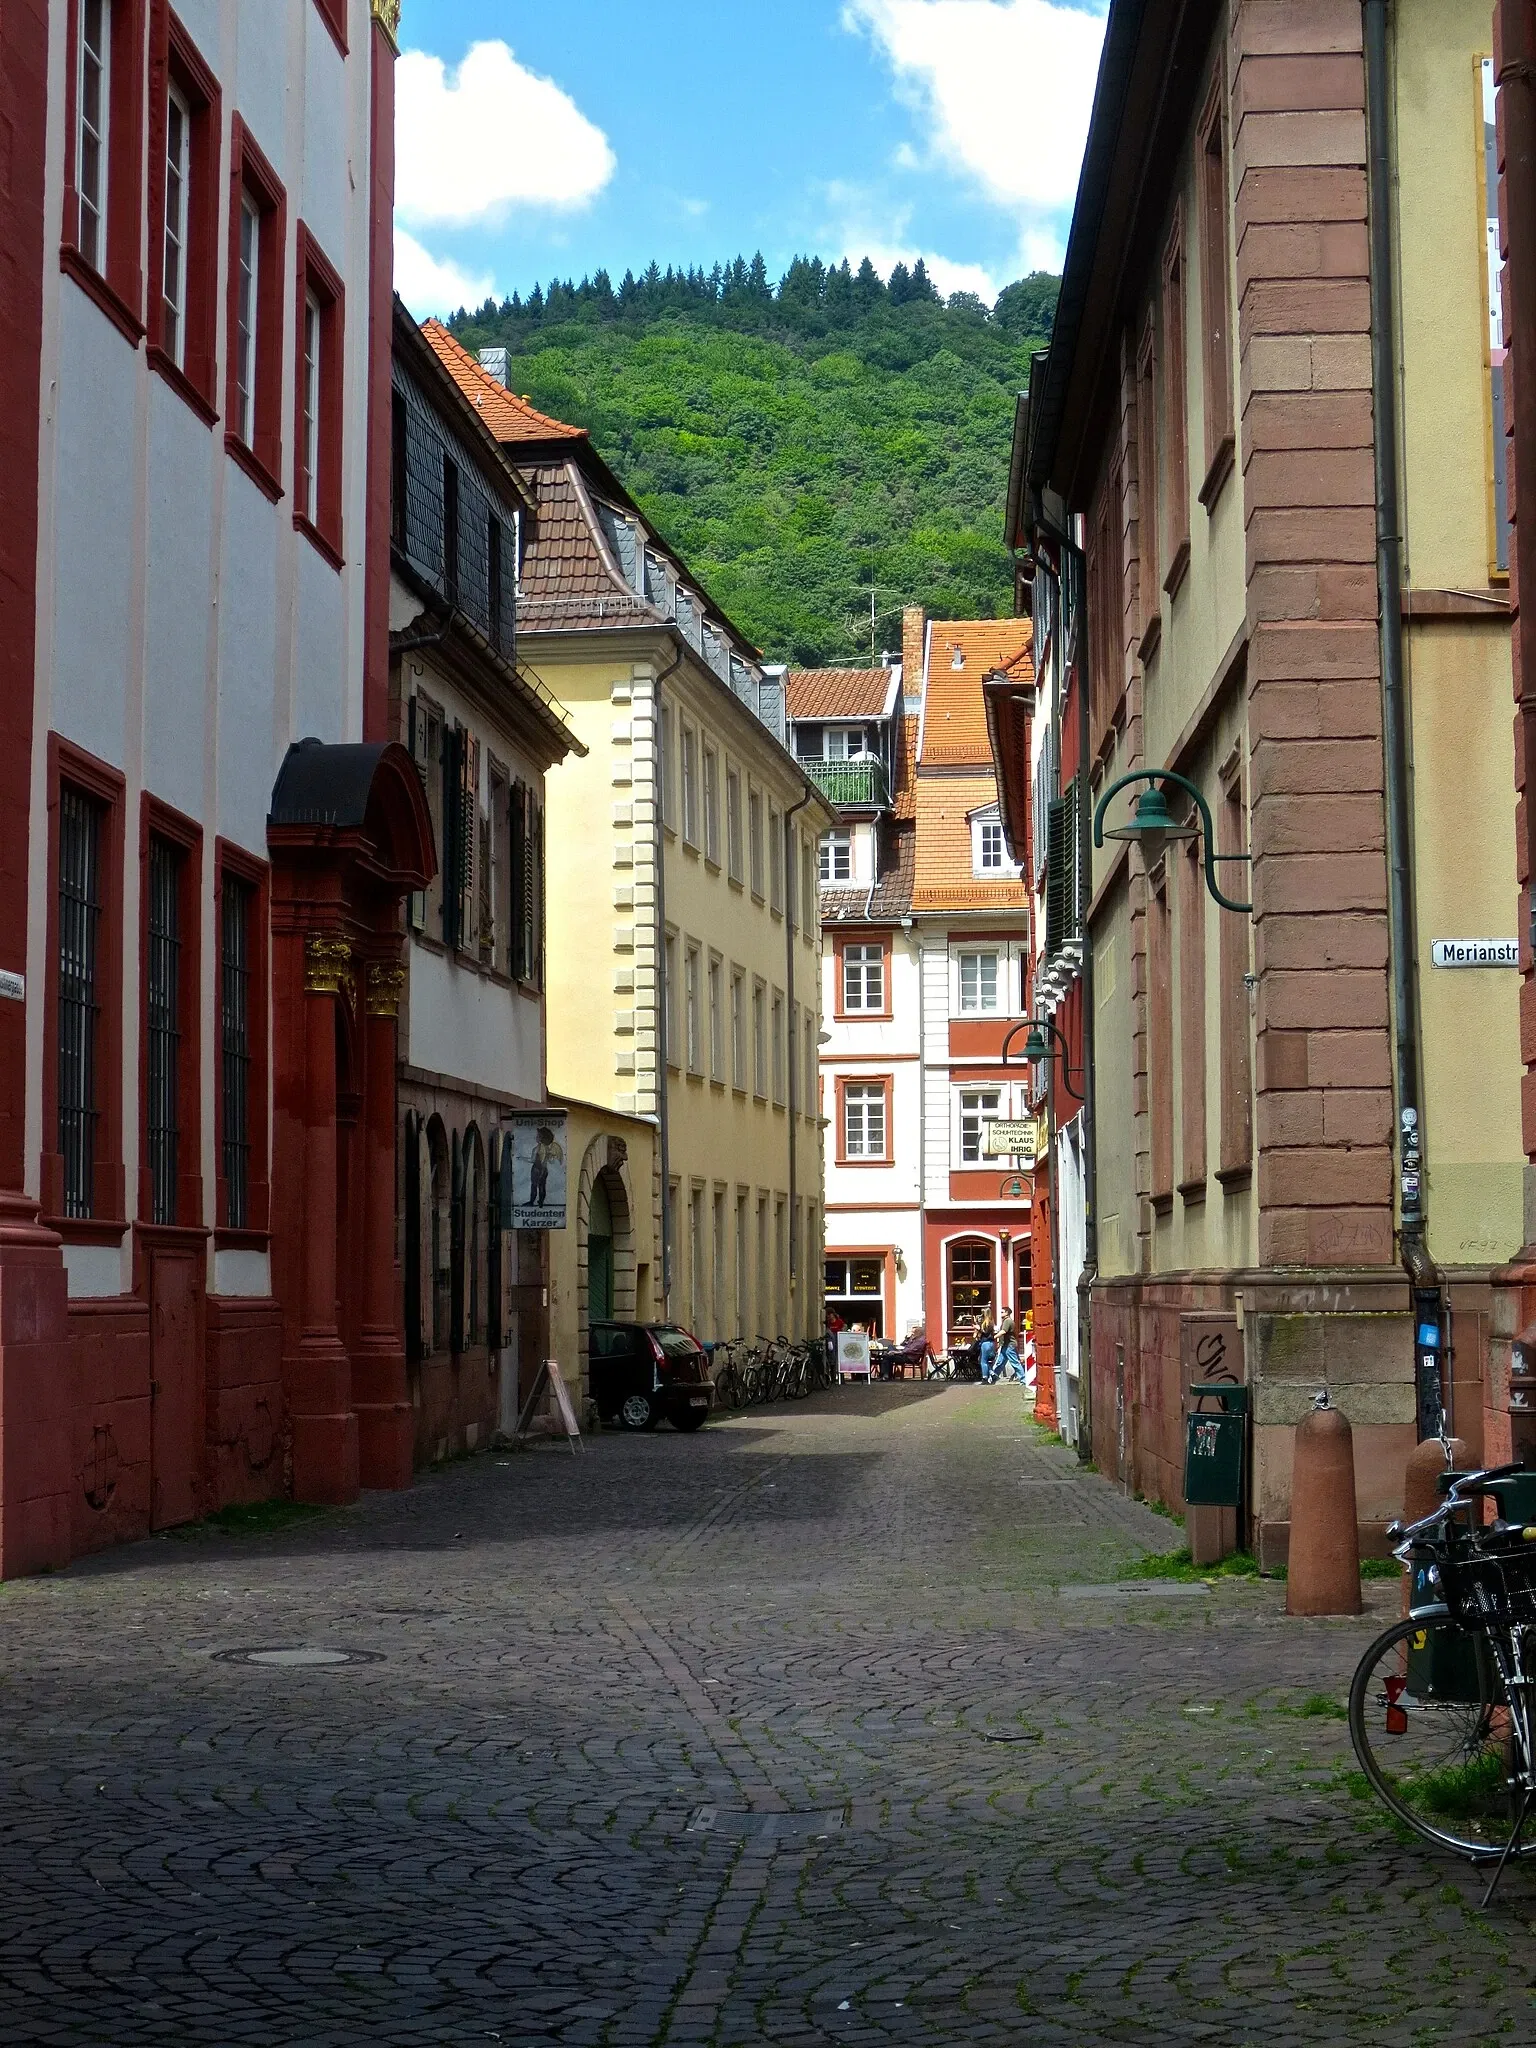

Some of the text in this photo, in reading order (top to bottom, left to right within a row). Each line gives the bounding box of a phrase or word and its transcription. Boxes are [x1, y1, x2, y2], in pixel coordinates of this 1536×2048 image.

[1443, 944, 1518, 961] Merianstr
[516, 1118, 564, 1128] Uni-Shop
[514, 1209, 565, 1218] Studenten
[522, 1218, 558, 1228] Karzer
